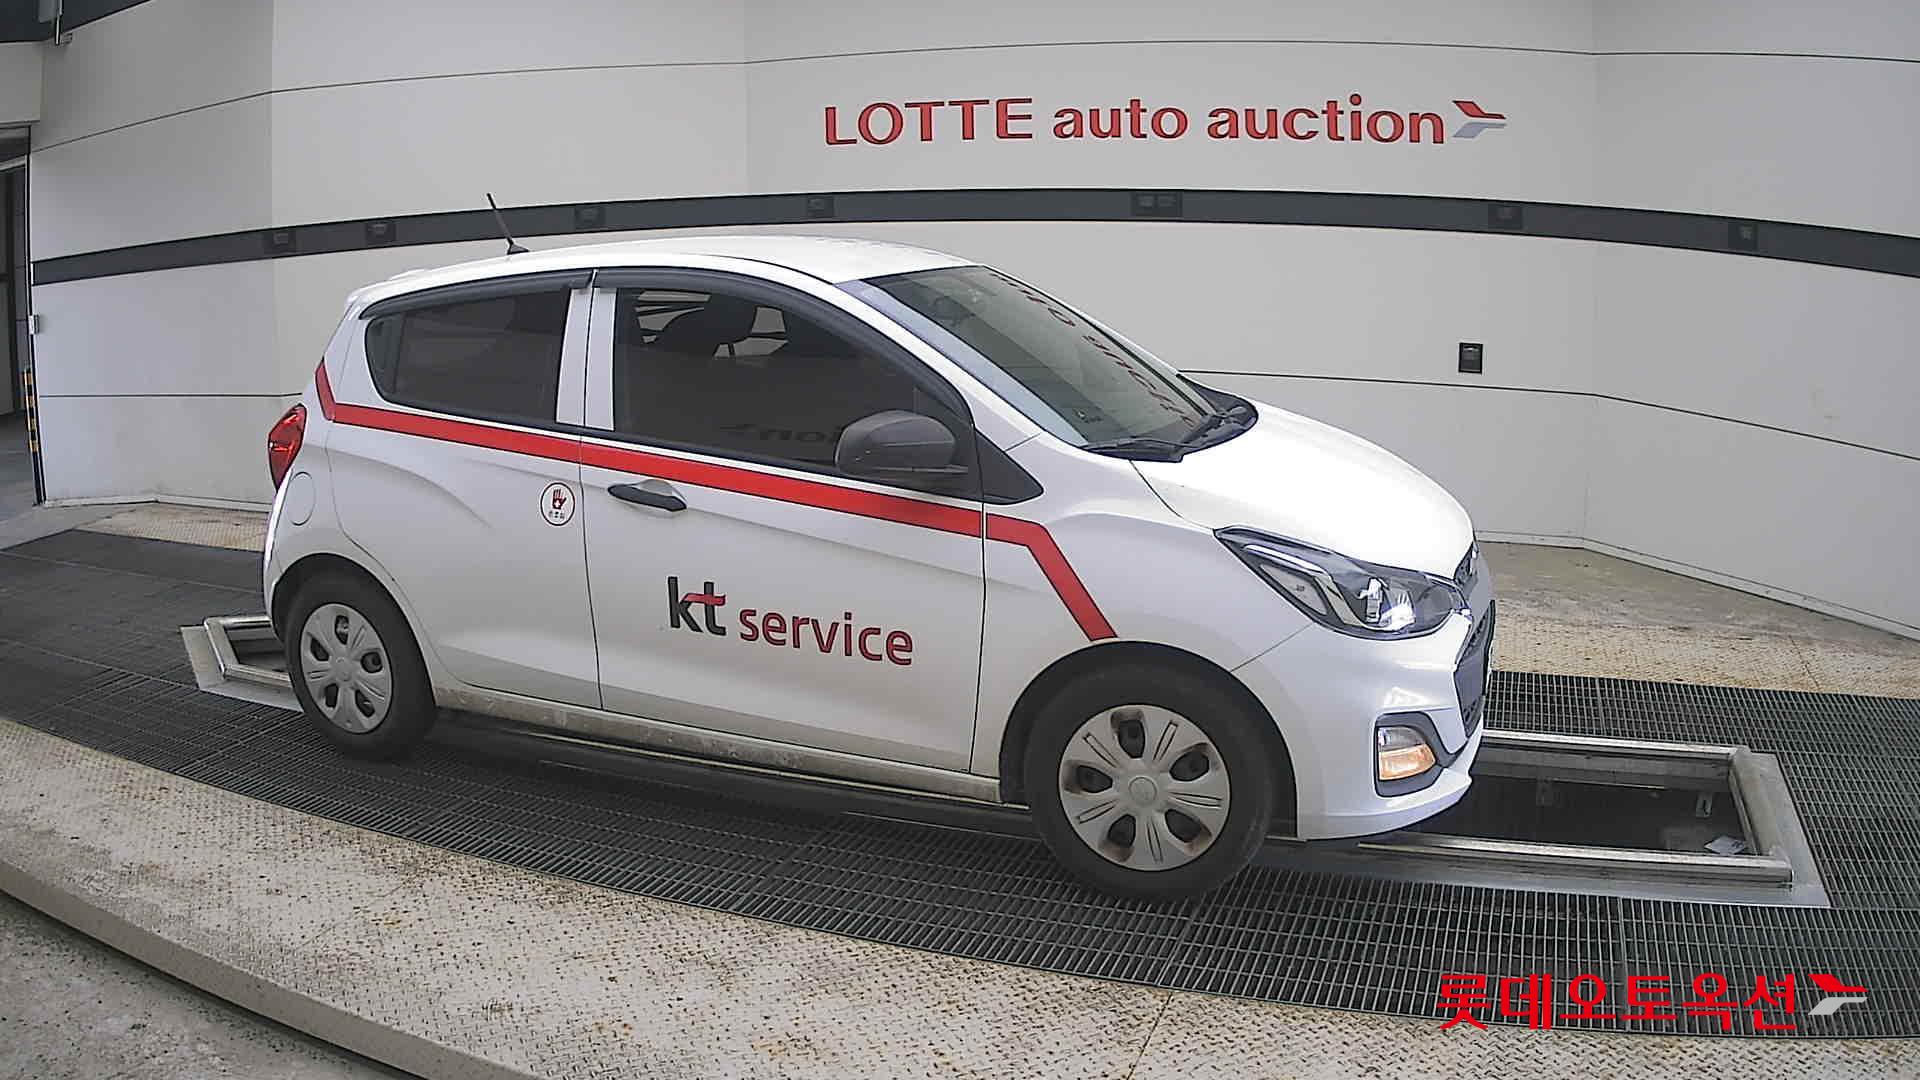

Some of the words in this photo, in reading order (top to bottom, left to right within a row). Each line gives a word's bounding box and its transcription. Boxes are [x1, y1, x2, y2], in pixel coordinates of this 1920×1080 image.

[825, 98, 1032, 145] LOTTE
[1053, 99, 1189, 139] auto
[1207, 93, 1445, 144] auction
[667, 576, 726, 636] kt
[739, 608, 913, 665] service
